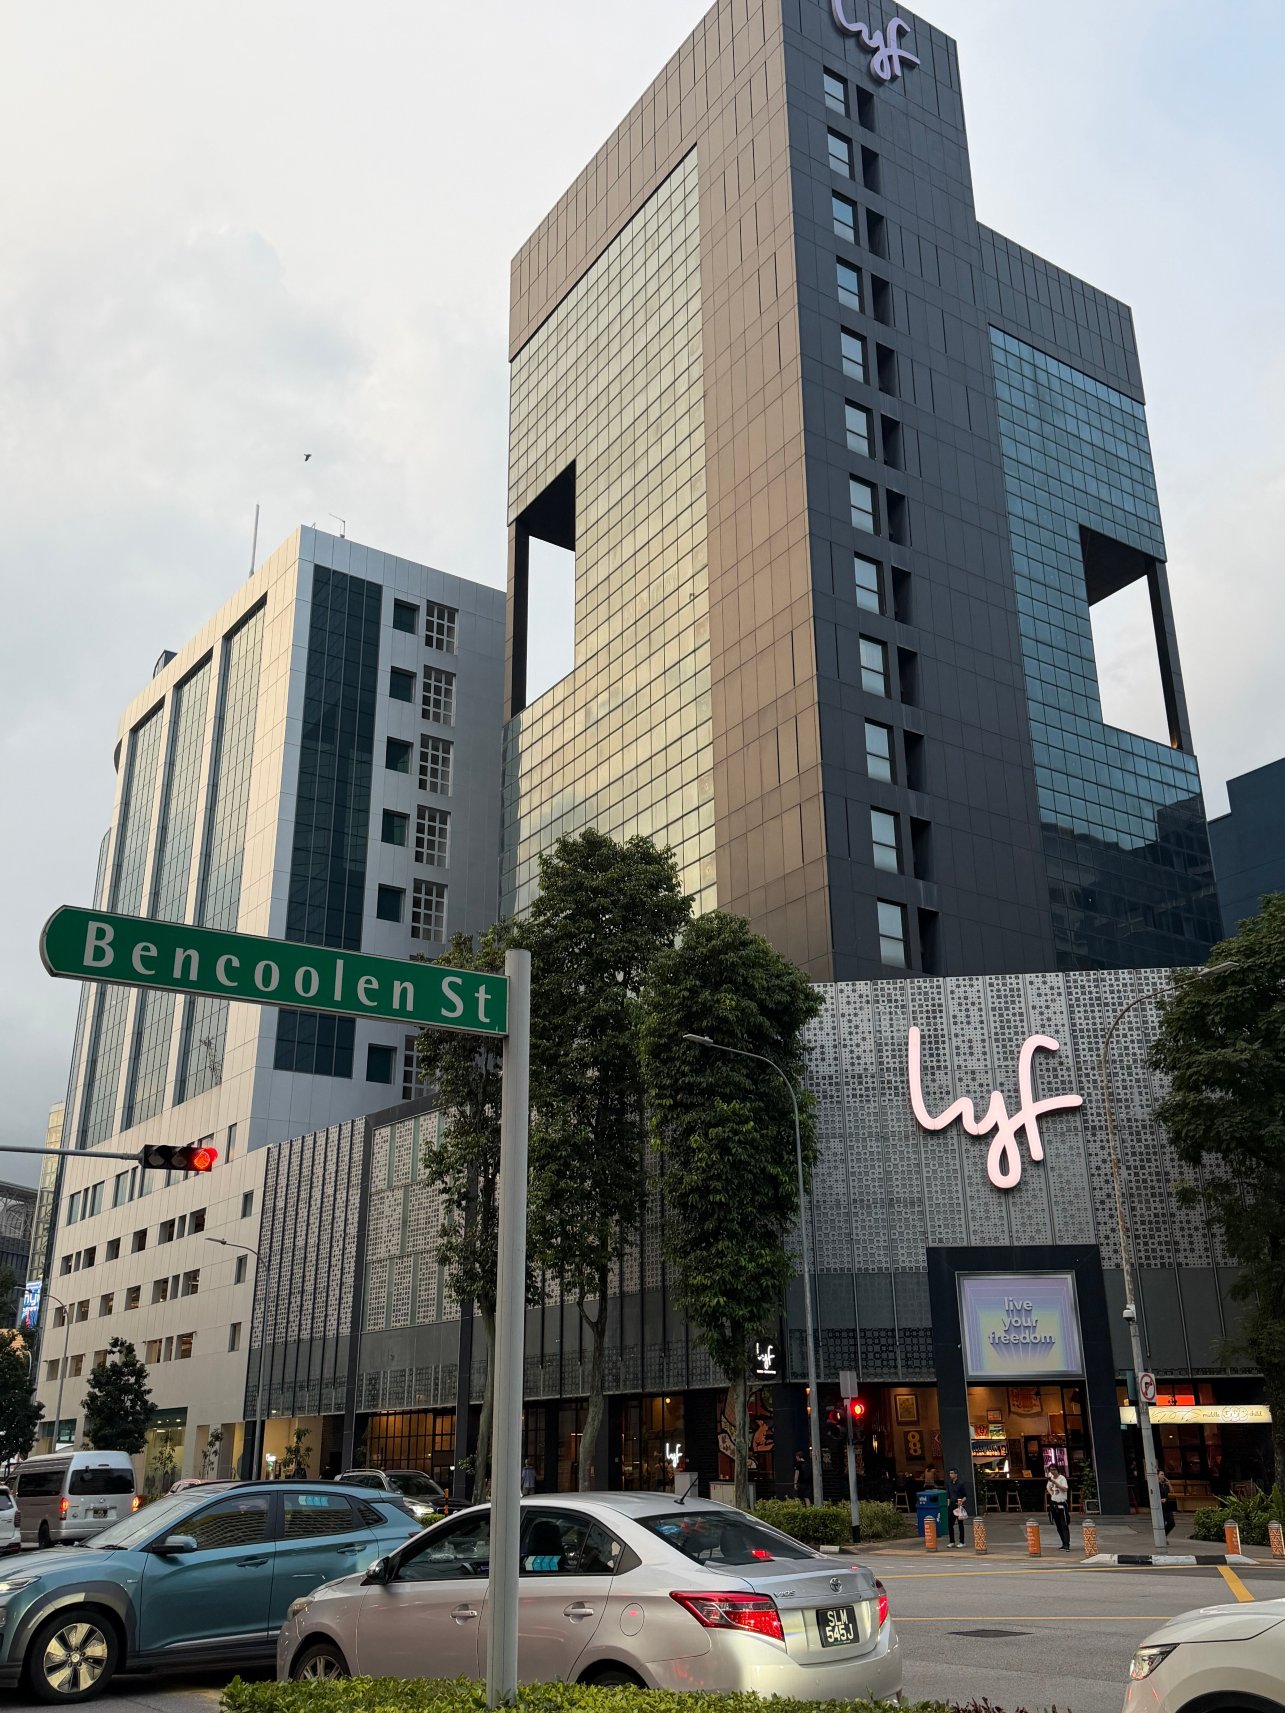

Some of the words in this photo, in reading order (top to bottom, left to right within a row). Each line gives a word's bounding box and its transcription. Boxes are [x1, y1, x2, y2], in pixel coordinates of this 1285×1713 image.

[83, 921, 415, 1012] Bencoolen
[441, 976, 493, 1024] St
[908, 1026, 1084, 1189] lyf
[1003, 1296, 1033, 1311] live
[1001, 1316, 1039, 1331] your
[988, 1329, 1056, 1345] freedom
[756, 1342, 776, 1370] lyf
[665, 1442, 683, 1468] lyf
[827, 1608, 848, 1627] SLM
[825, 1624, 854, 1643] 545J
